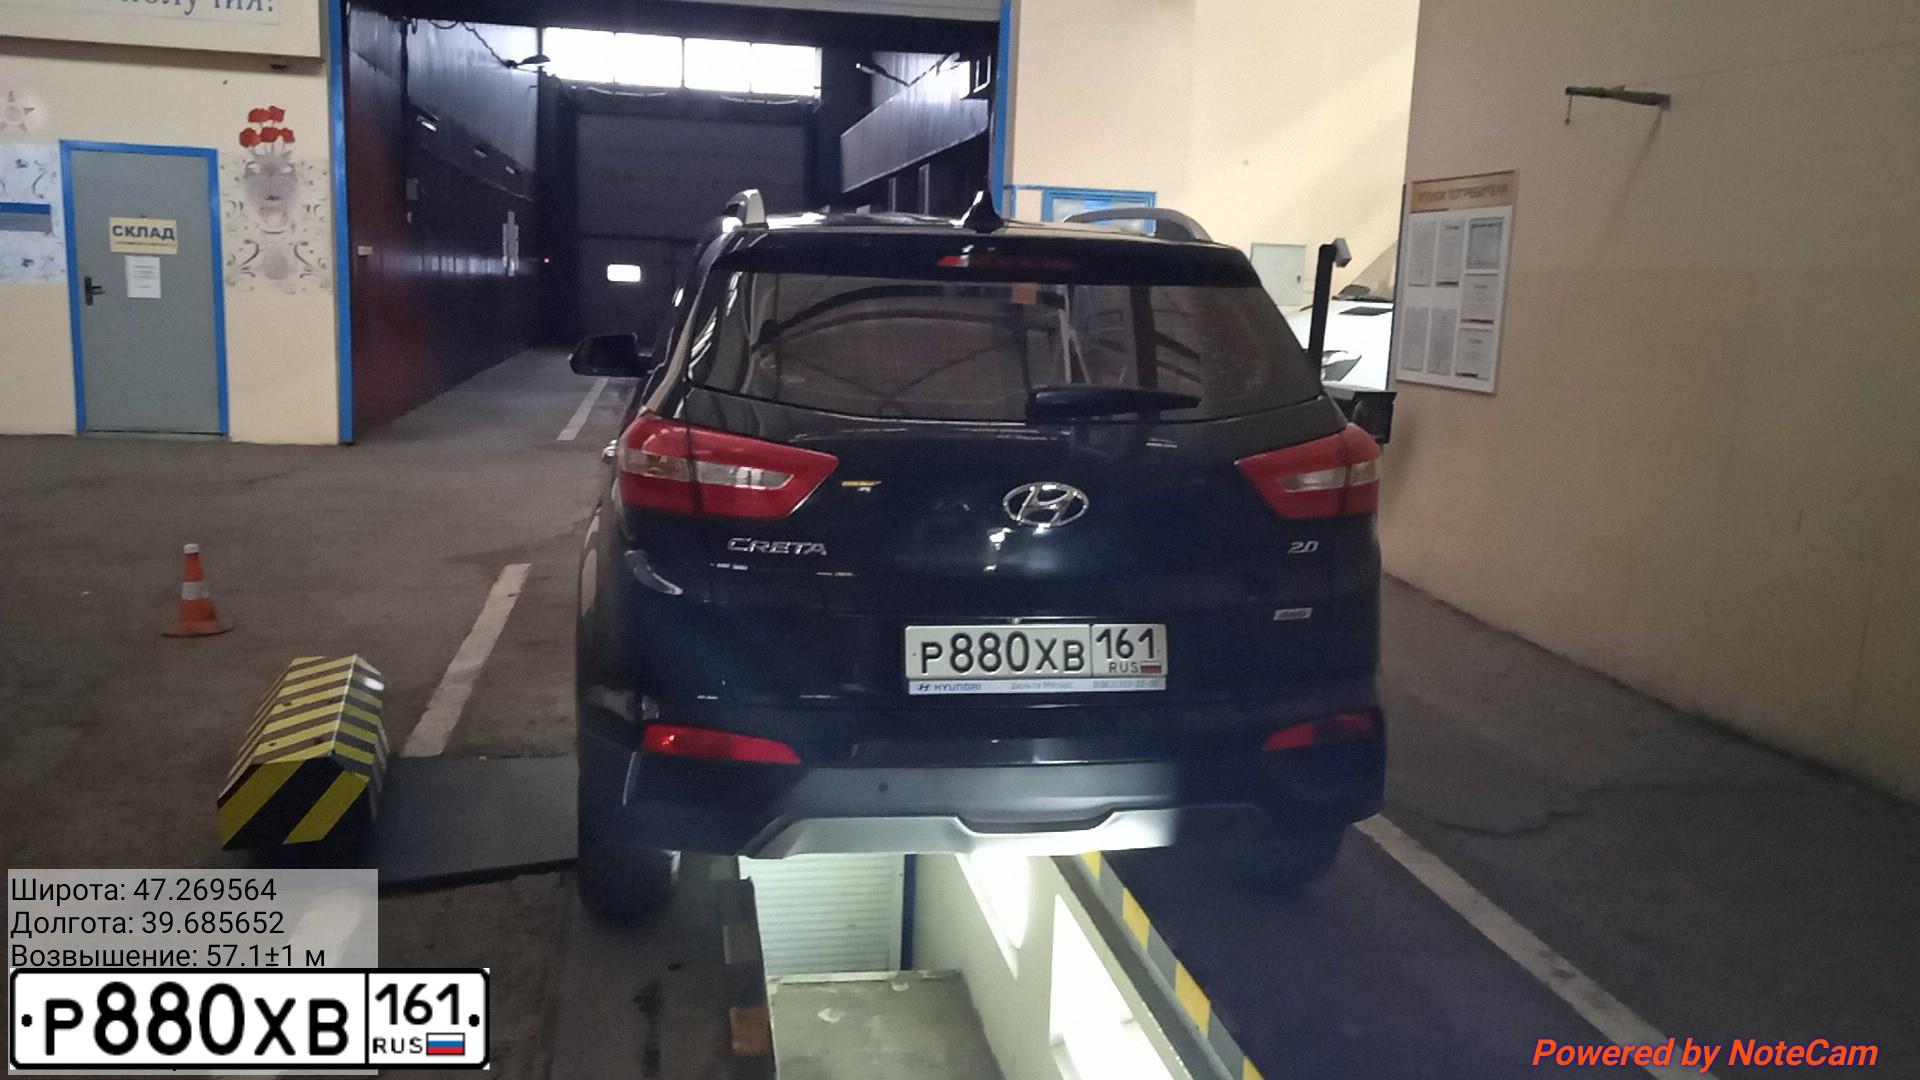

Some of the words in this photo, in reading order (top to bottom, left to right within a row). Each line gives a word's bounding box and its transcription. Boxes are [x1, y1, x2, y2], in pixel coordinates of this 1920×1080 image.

[111, 224, 176, 241] СКЛАД
[727, 537, 828, 556] CRETA
[920, 630, 1085, 674] Р880ХВ
[1095, 627, 1156, 660] 161
[1108, 661, 1139, 674] RUS
